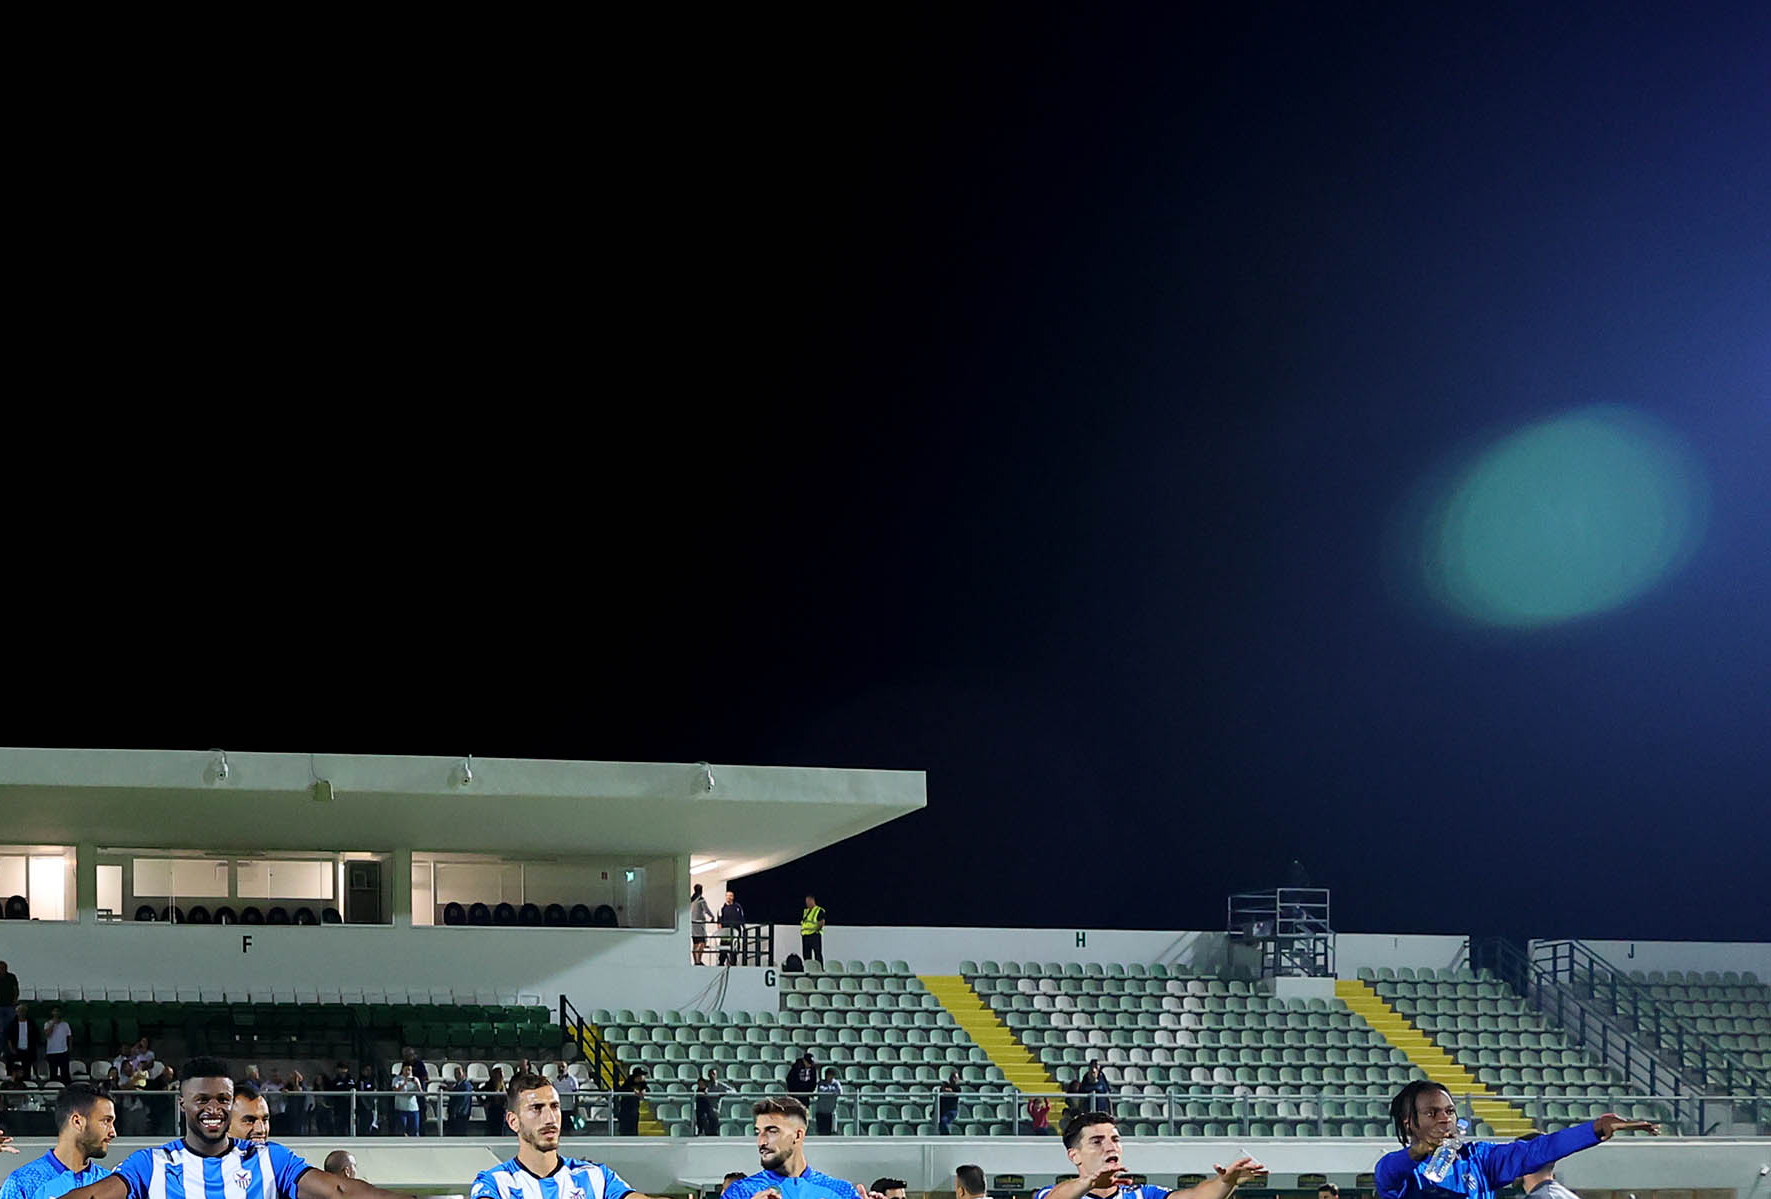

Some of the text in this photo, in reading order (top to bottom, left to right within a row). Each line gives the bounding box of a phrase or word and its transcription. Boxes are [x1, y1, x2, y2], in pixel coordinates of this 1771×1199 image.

[242, 935, 253, 953] F
[1076, 931, 1086, 948] H
[1628, 943, 1635, 959] J
[764, 969, 777, 988] G
